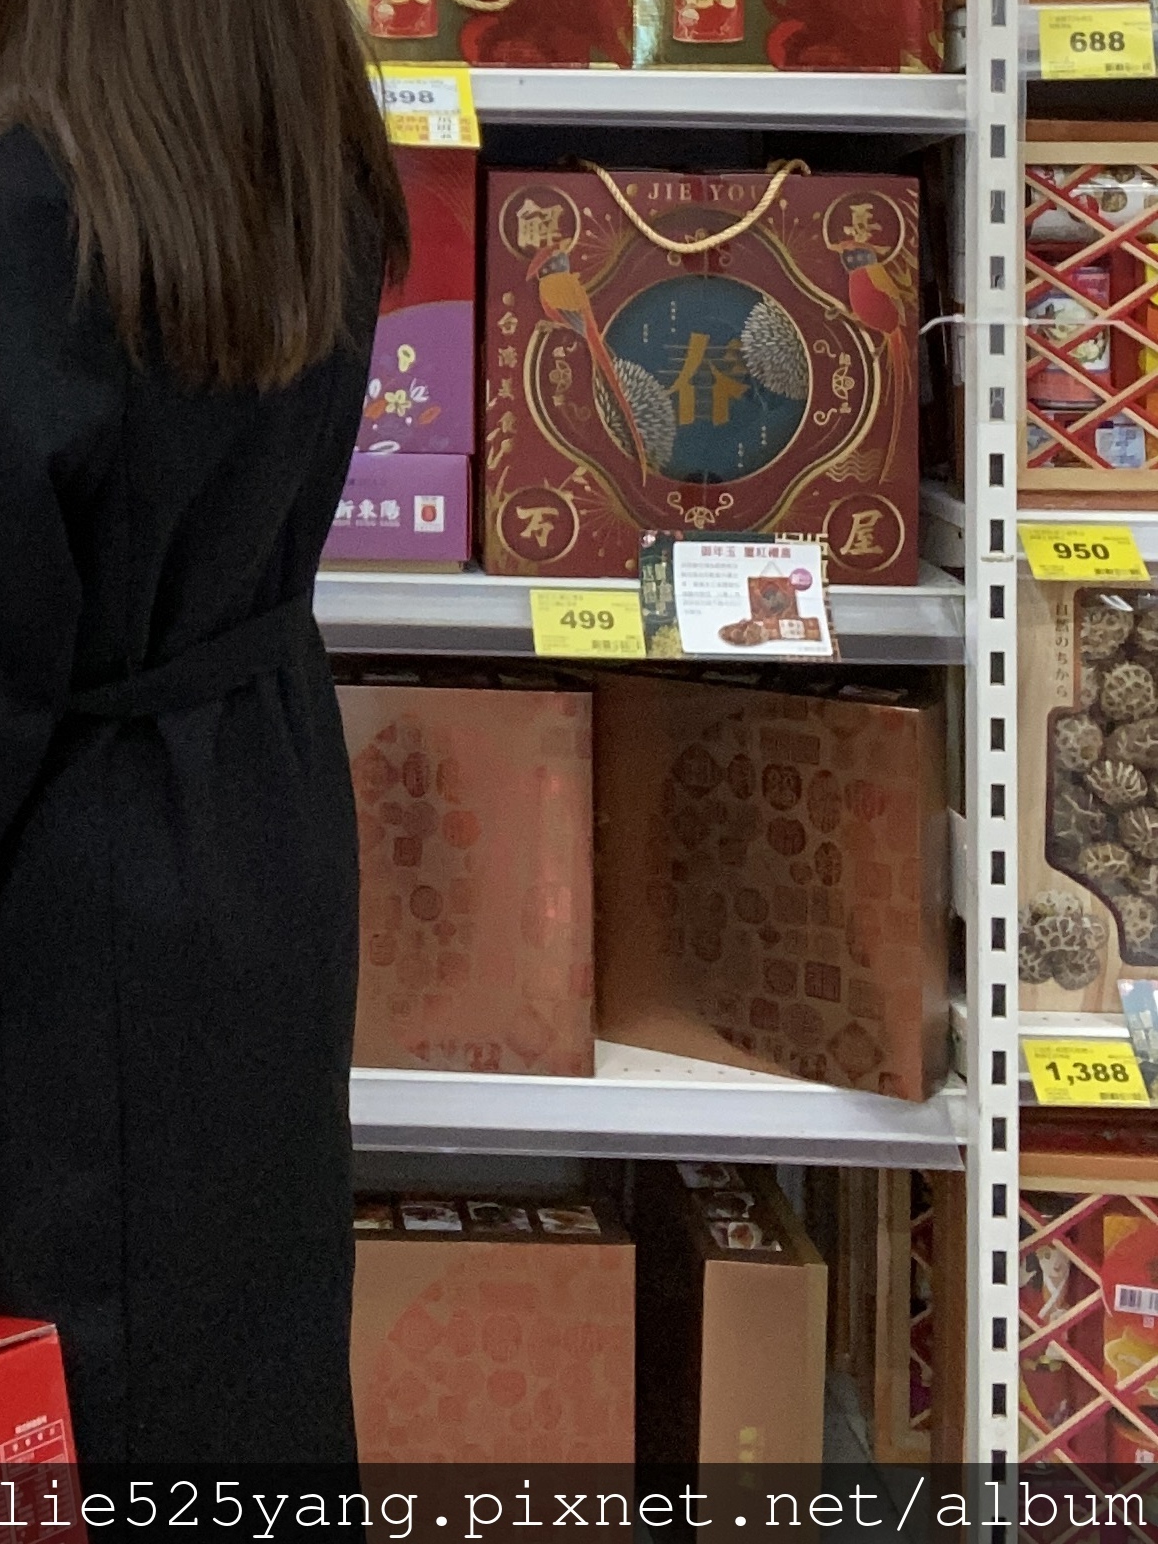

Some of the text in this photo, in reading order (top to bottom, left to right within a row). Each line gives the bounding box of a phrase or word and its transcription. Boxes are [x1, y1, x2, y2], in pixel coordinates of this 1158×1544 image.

[1070, 31, 1126, 53] 688
[648, 183, 691, 200] JIE
[1053, 542, 1110, 561] 950
[560, 610, 615, 630] 499
[1045, 1060, 1130, 1086] 1,388
